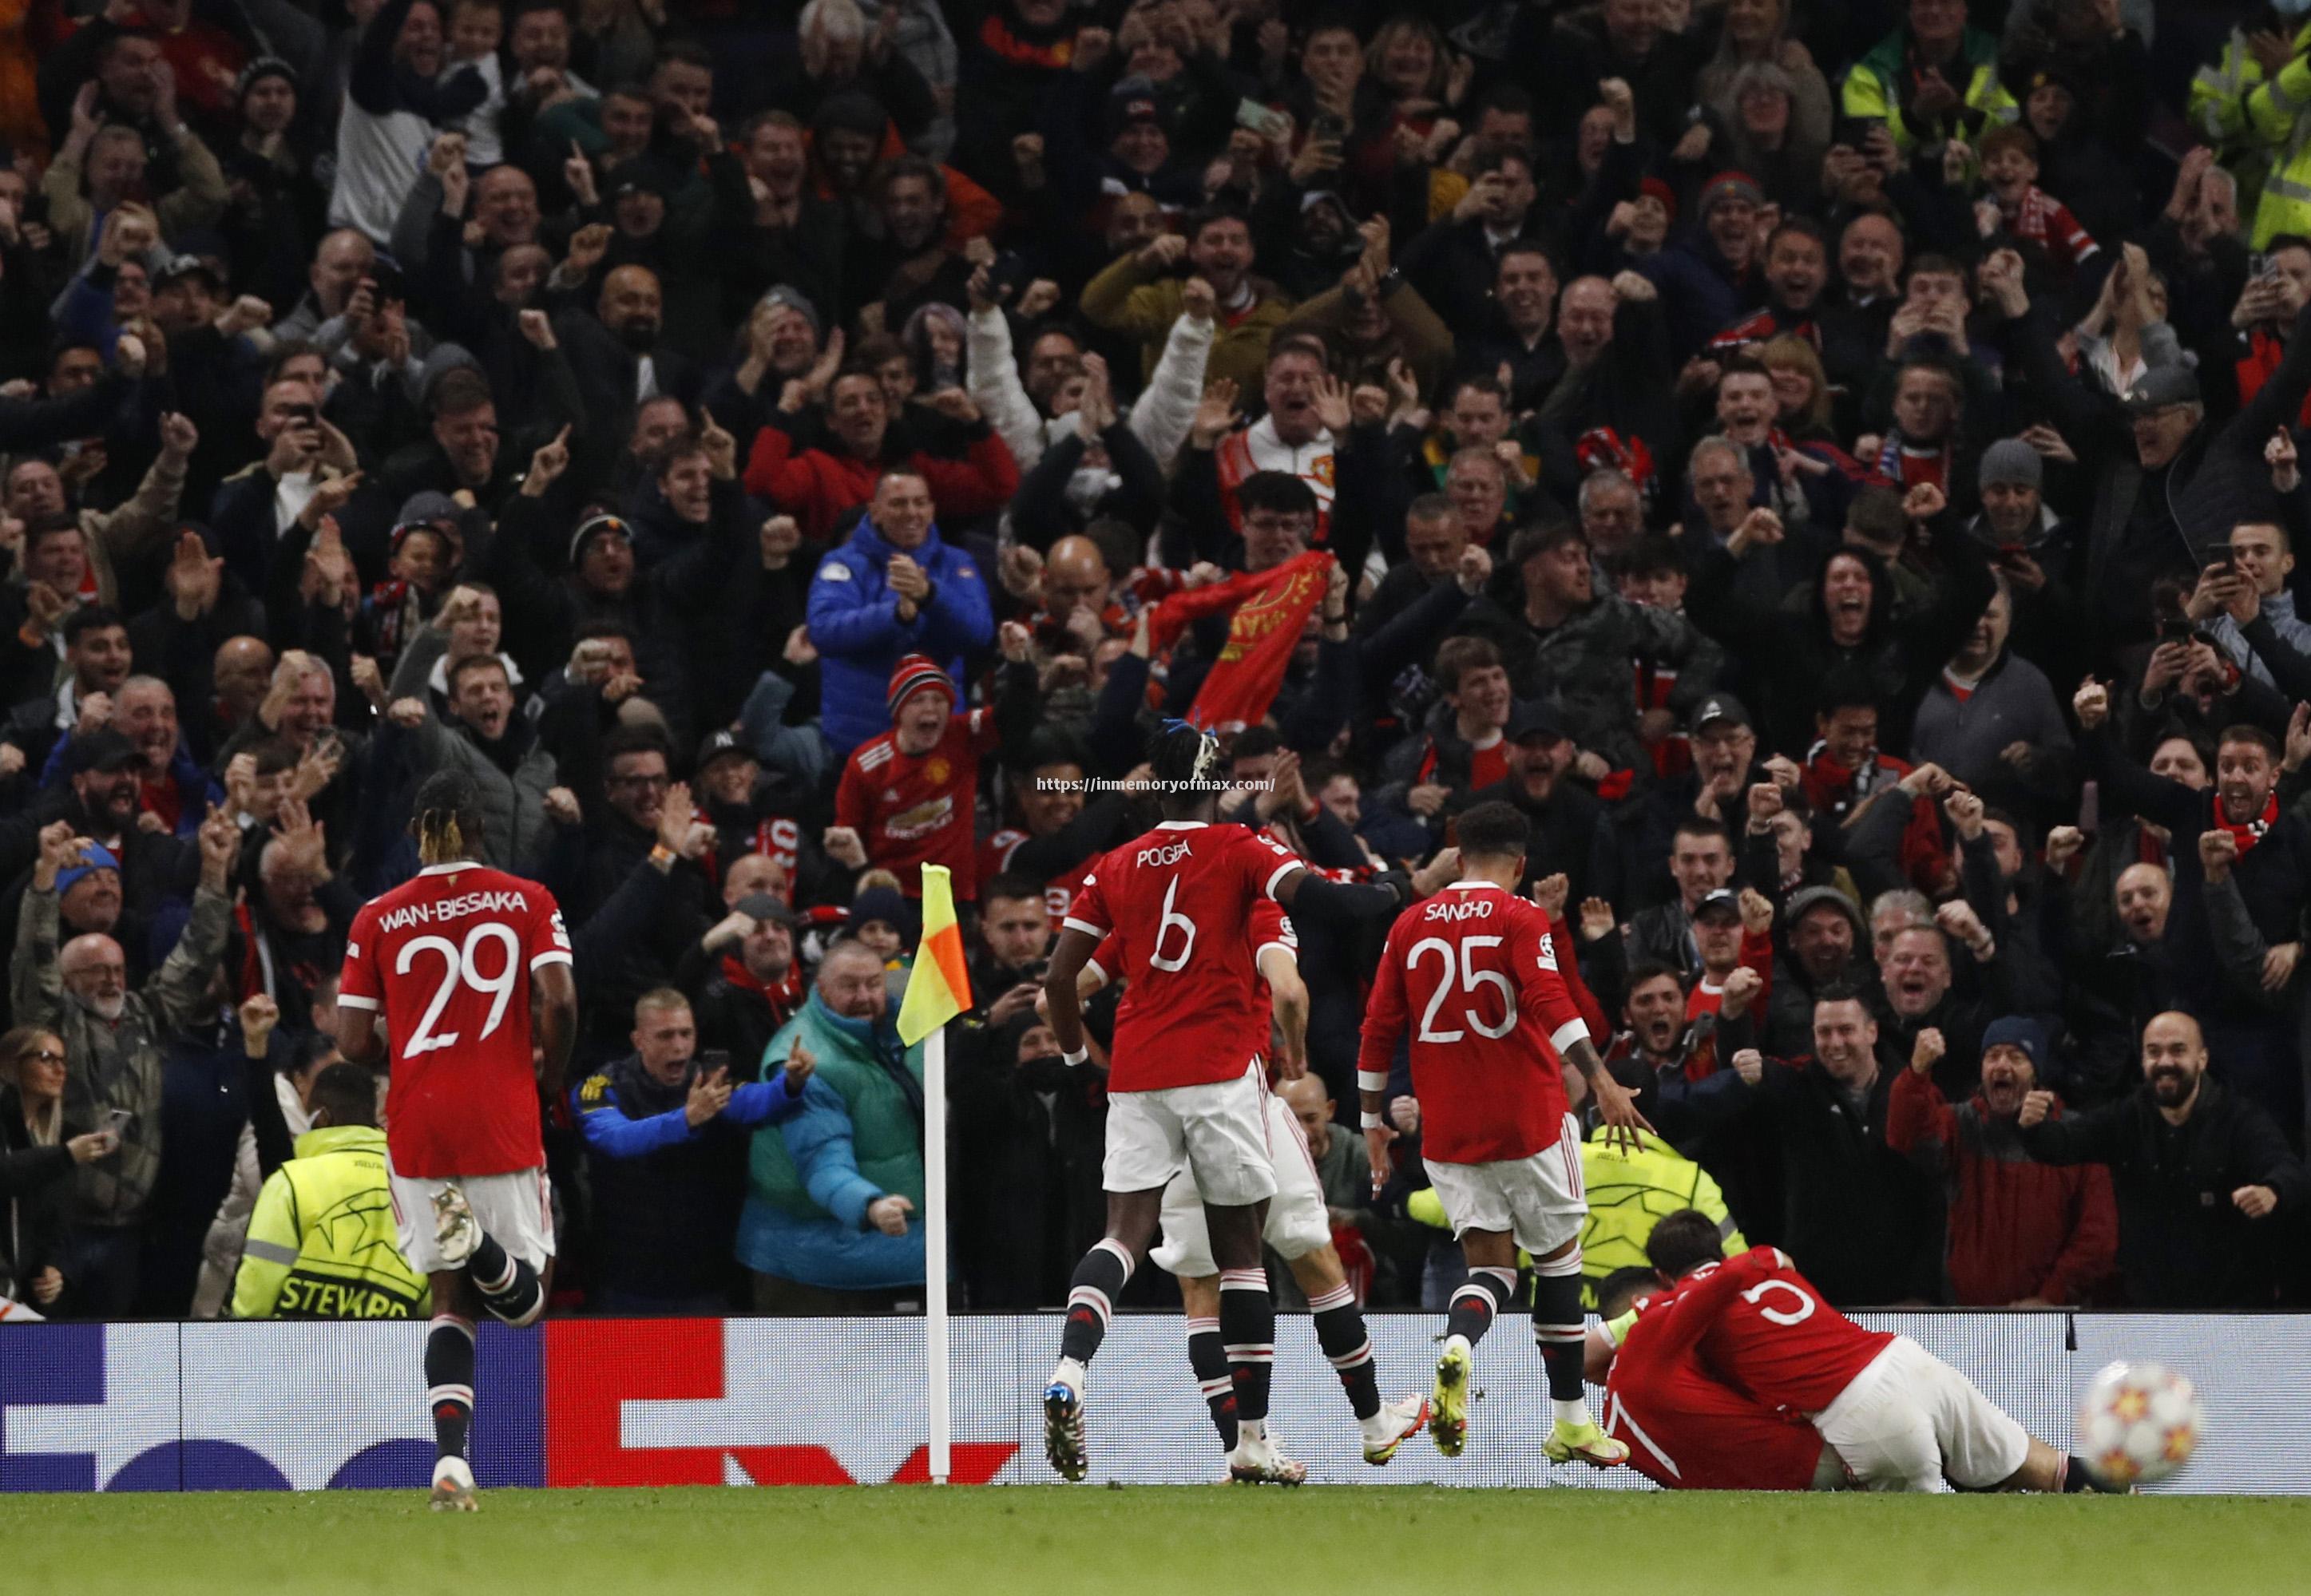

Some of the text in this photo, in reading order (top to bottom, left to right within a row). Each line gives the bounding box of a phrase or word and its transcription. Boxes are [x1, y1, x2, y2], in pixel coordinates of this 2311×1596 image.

[379, 892, 528, 933] WAN-BISSAKA
[1150, 873, 1196, 972] 6
[1424, 900, 1493, 924] SANCHO
[395, 922, 519, 1059] 29
[1407, 935, 1517, 1043] 25
